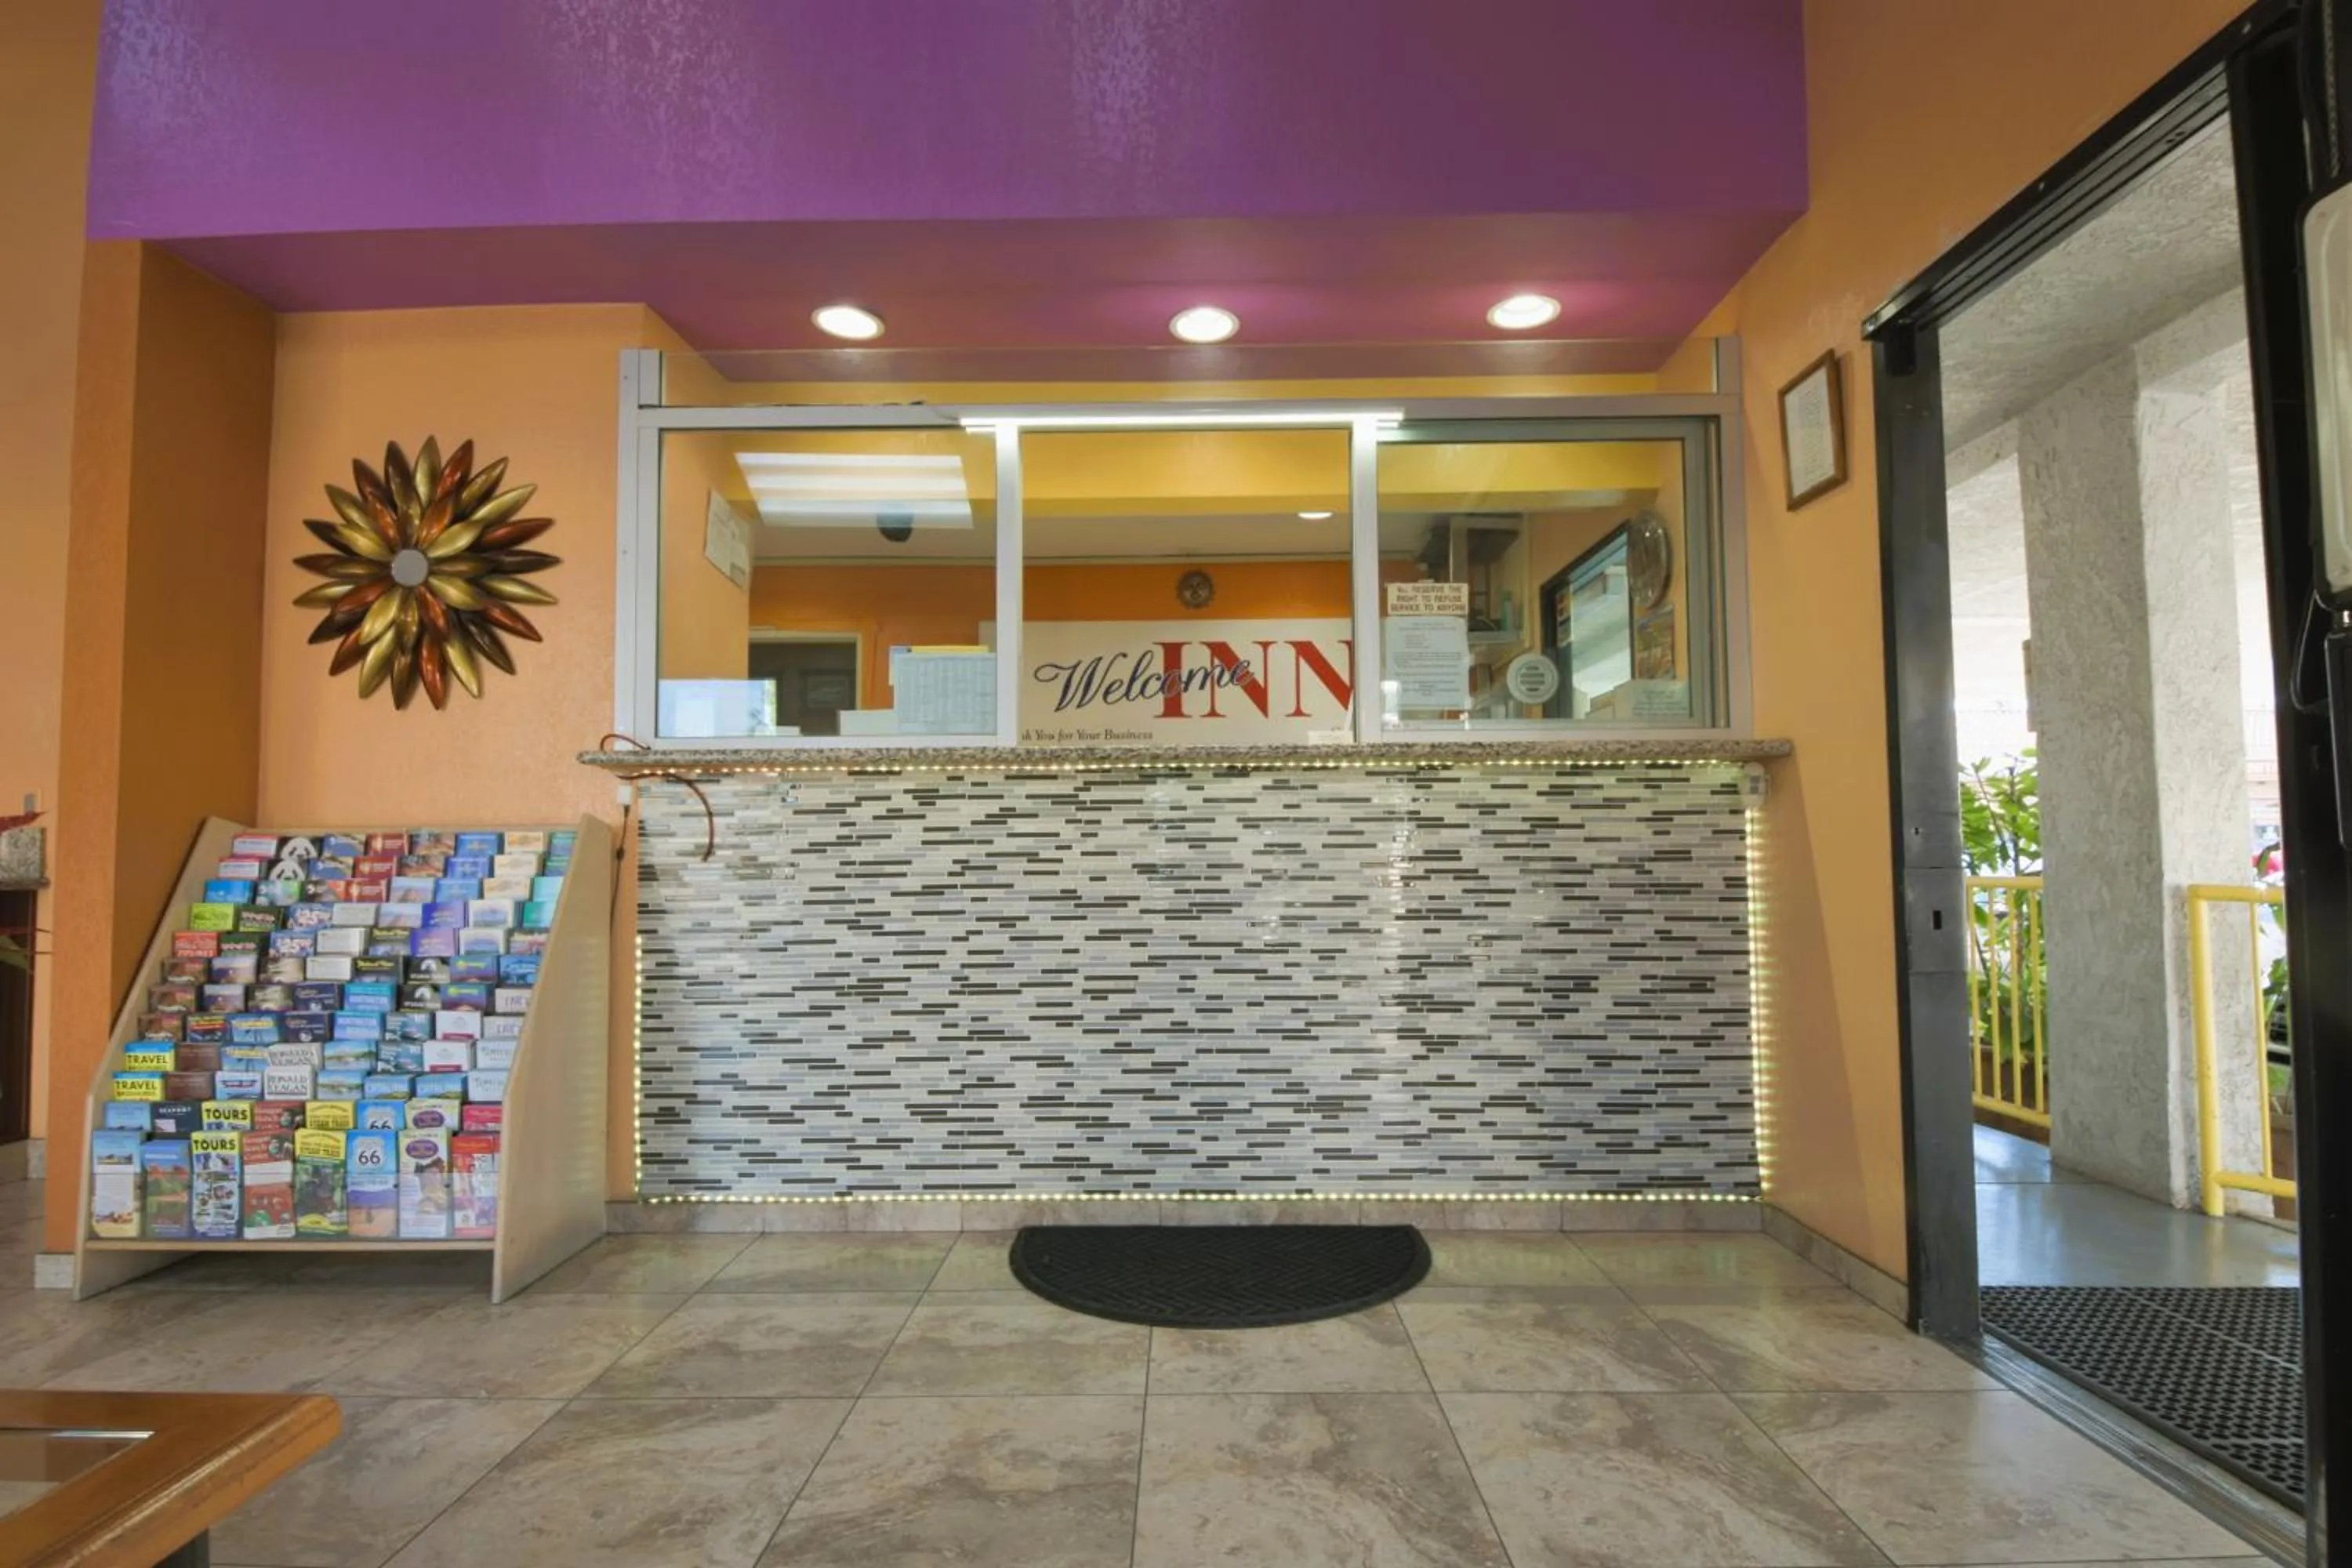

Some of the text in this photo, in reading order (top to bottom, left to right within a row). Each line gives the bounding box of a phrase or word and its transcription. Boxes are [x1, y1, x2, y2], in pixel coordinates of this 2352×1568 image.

[1390, 603, 1420, 612] SERVICE
[1425, 603, 1434, 612] TO
[1033, 651, 1256, 713] Welcome
[1152, 640, 1355, 719] INN
[1035, 728, 1054, 741] You
[1058, 728, 1073, 742] for
[1076, 728, 1101, 741] Your
[1104, 729, 1153, 740] Business
[127, 1054, 169, 1065] TRAVEL
[115, 1080, 158, 1091] TRAVEL
[204, 1108, 249, 1120] TOURS
[193, 1138, 237, 1151] TOURS
[358, 1150, 381, 1165] 66
